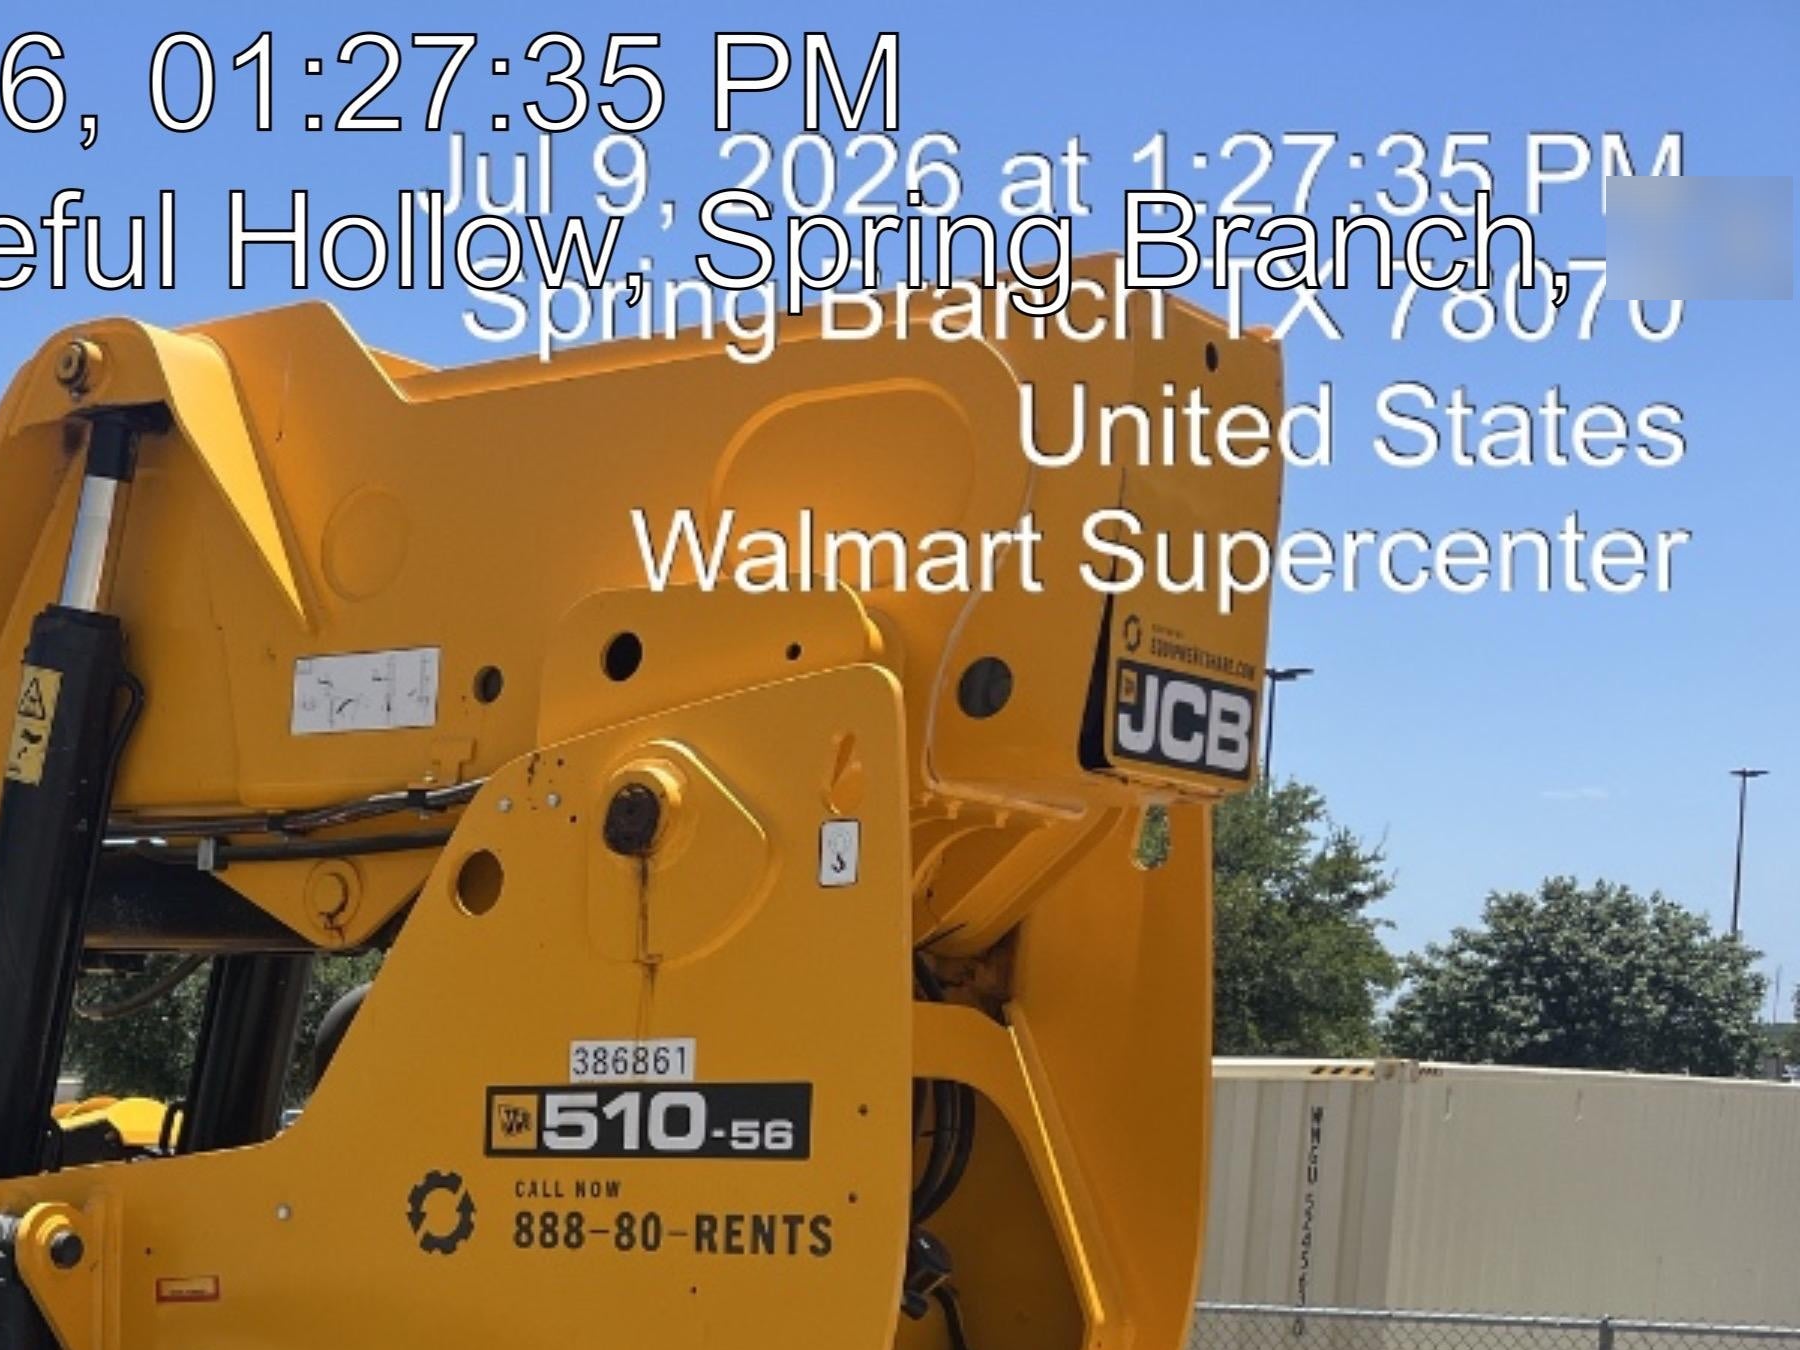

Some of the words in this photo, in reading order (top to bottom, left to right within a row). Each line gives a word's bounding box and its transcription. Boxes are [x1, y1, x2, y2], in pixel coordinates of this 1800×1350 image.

[1117, 673, 1253, 772] JCB
[572, 1046, 688, 1075] 386861
[543, 1091, 794, 1152] 510-56
[515, 1181, 564, 1199] CALL
[575, 1181, 622, 1199] NOW
[513, 1211, 833, 1257] 888-80-RENTS
